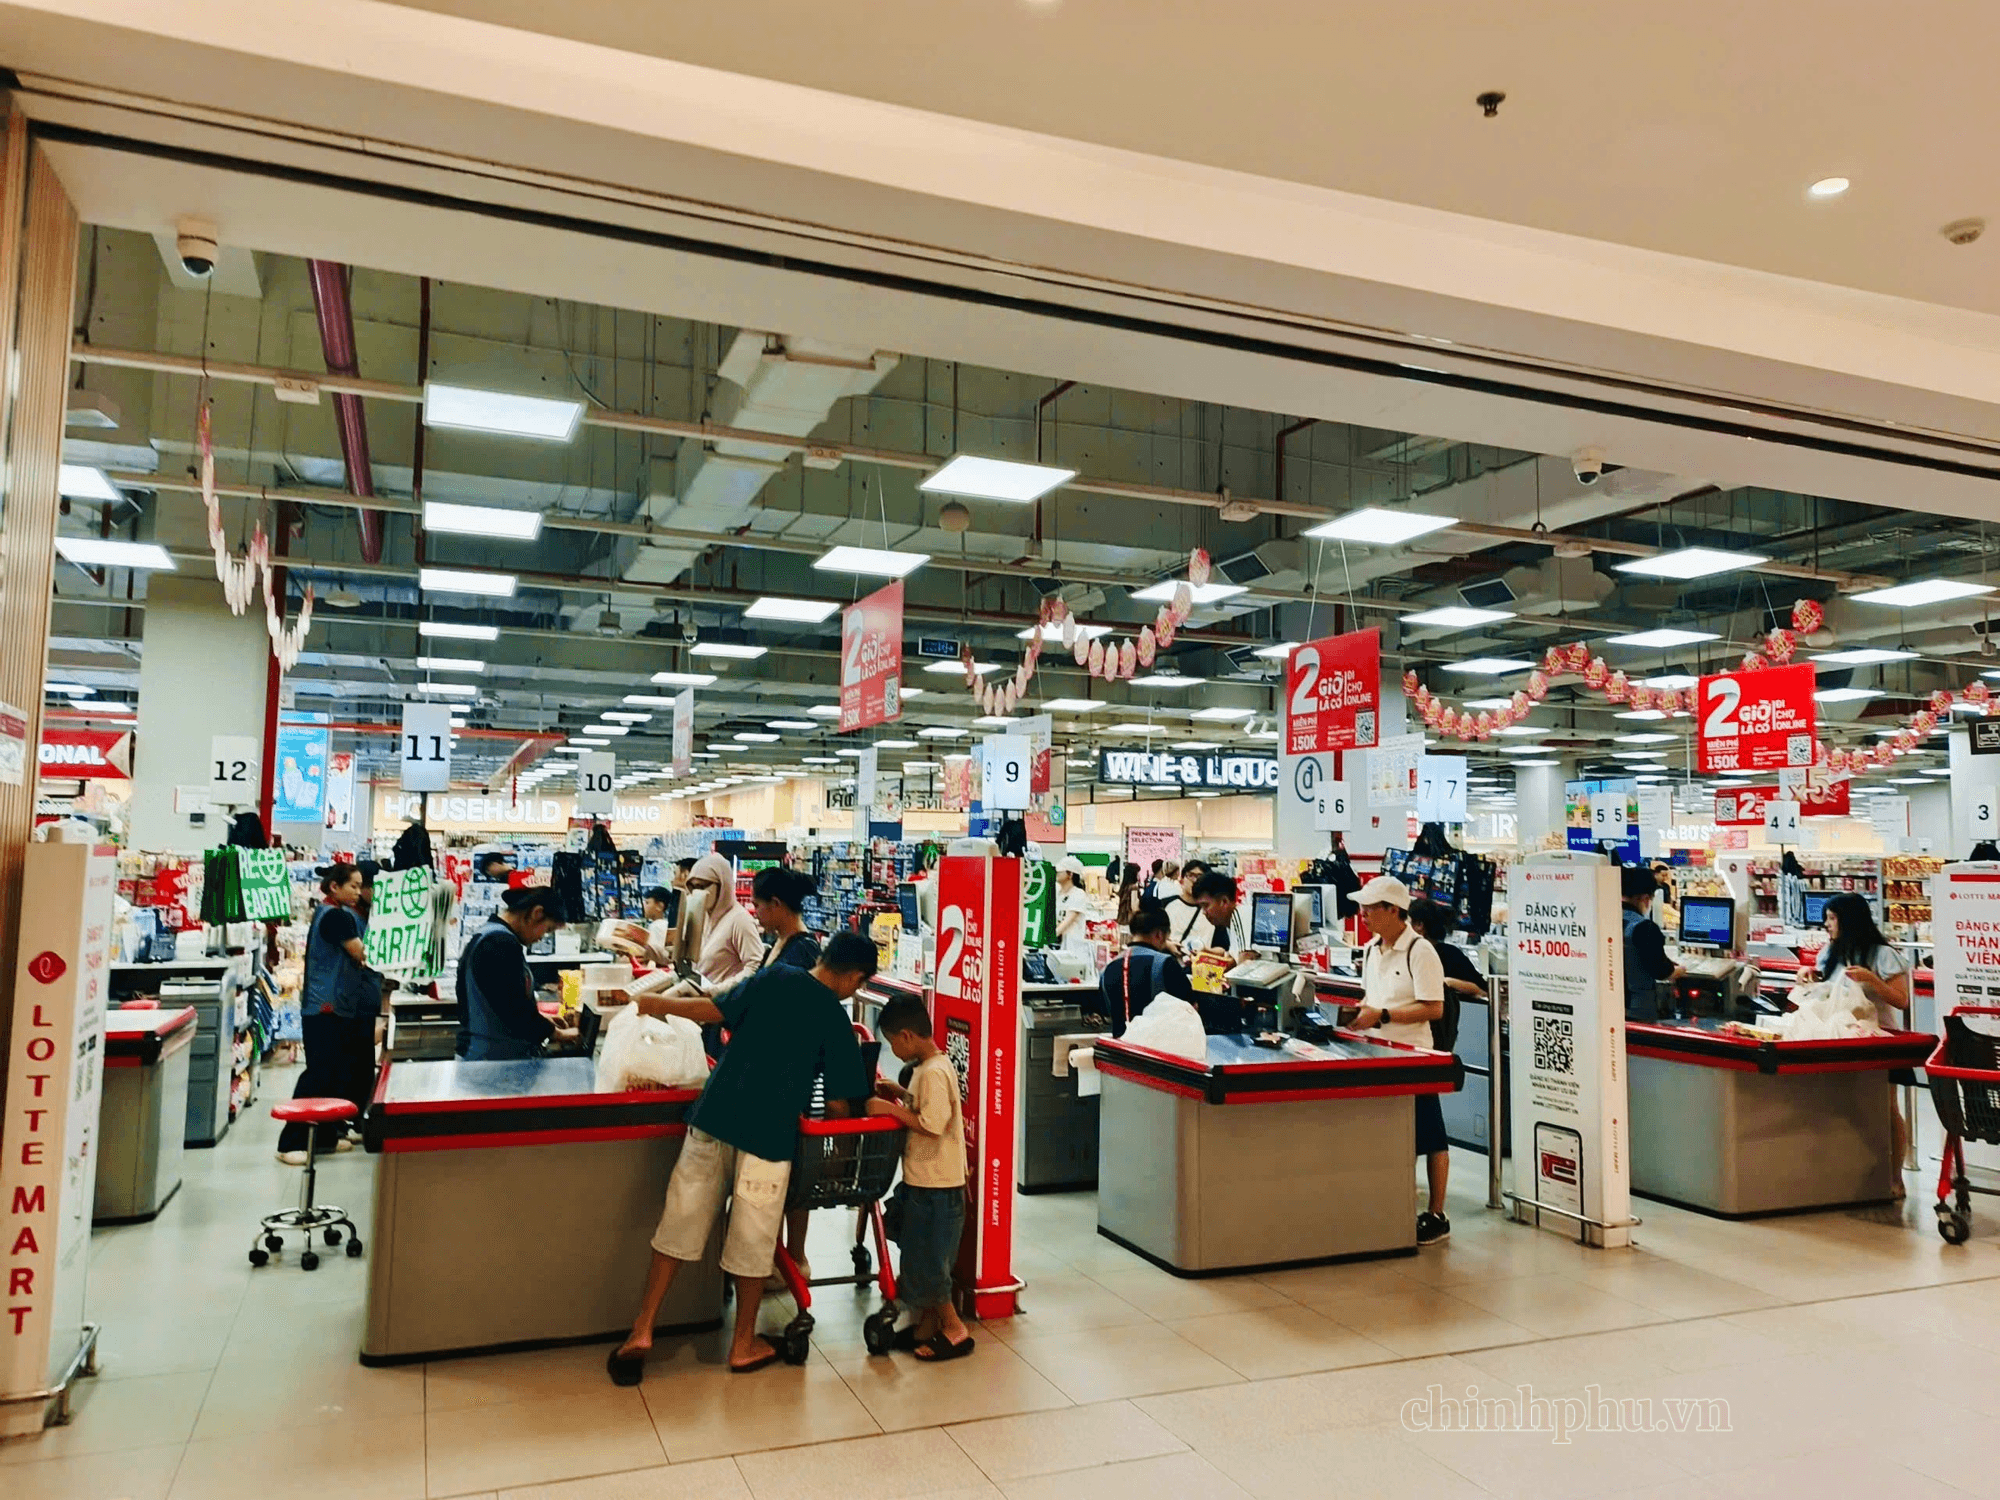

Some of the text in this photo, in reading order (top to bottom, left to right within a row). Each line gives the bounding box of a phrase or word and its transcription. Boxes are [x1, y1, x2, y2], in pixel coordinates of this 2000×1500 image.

[844, 609, 863, 687] 2
[1291, 647, 1320, 715] 2
[1347, 692, 1372, 705] ONLINE
[1704, 677, 1741, 738] 2
[1776, 719, 1806, 730] ONLINE
[406, 735, 445, 761] 11
[1292, 734, 1318, 751] 150K
[38, 744, 106, 765] ONAL
[1707, 754, 1739, 769] 150K
[214, 761, 247, 781] 12
[1006, 761, 1019, 782] 9
[1106, 752, 1279, 787] WINE & LIQUO
[585, 773, 612, 792] 10
[1424, 780, 1431, 799] 7
[1447, 780, 1457, 799] 7
[384, 795, 561, 824] HOUSEHOLD
[1319, 799, 1325, 813] 6
[1335, 799, 1344, 813] 6
[1597, 808, 1605, 822] 5
[1615, 808, 1622, 822] 5
[1738, 792, 1756, 819] 2
[1978, 804, 1989, 820] 3
[1770, 816, 1779, 829] 4
[1788, 816, 1795, 828] 4
[1554, 873, 1574, 881] MART
[242, 886, 291, 919] EARTH
[1517, 919, 1586, 937] THÀNH VIÊN
[364, 921, 430, 966] EARTH
[1518, 939, 1570, 957] +15,000
[1956, 932, 1999, 949] THÀN
[936, 904, 965, 998] 2
[7, 1005, 55, 1335] LOTTE MART
